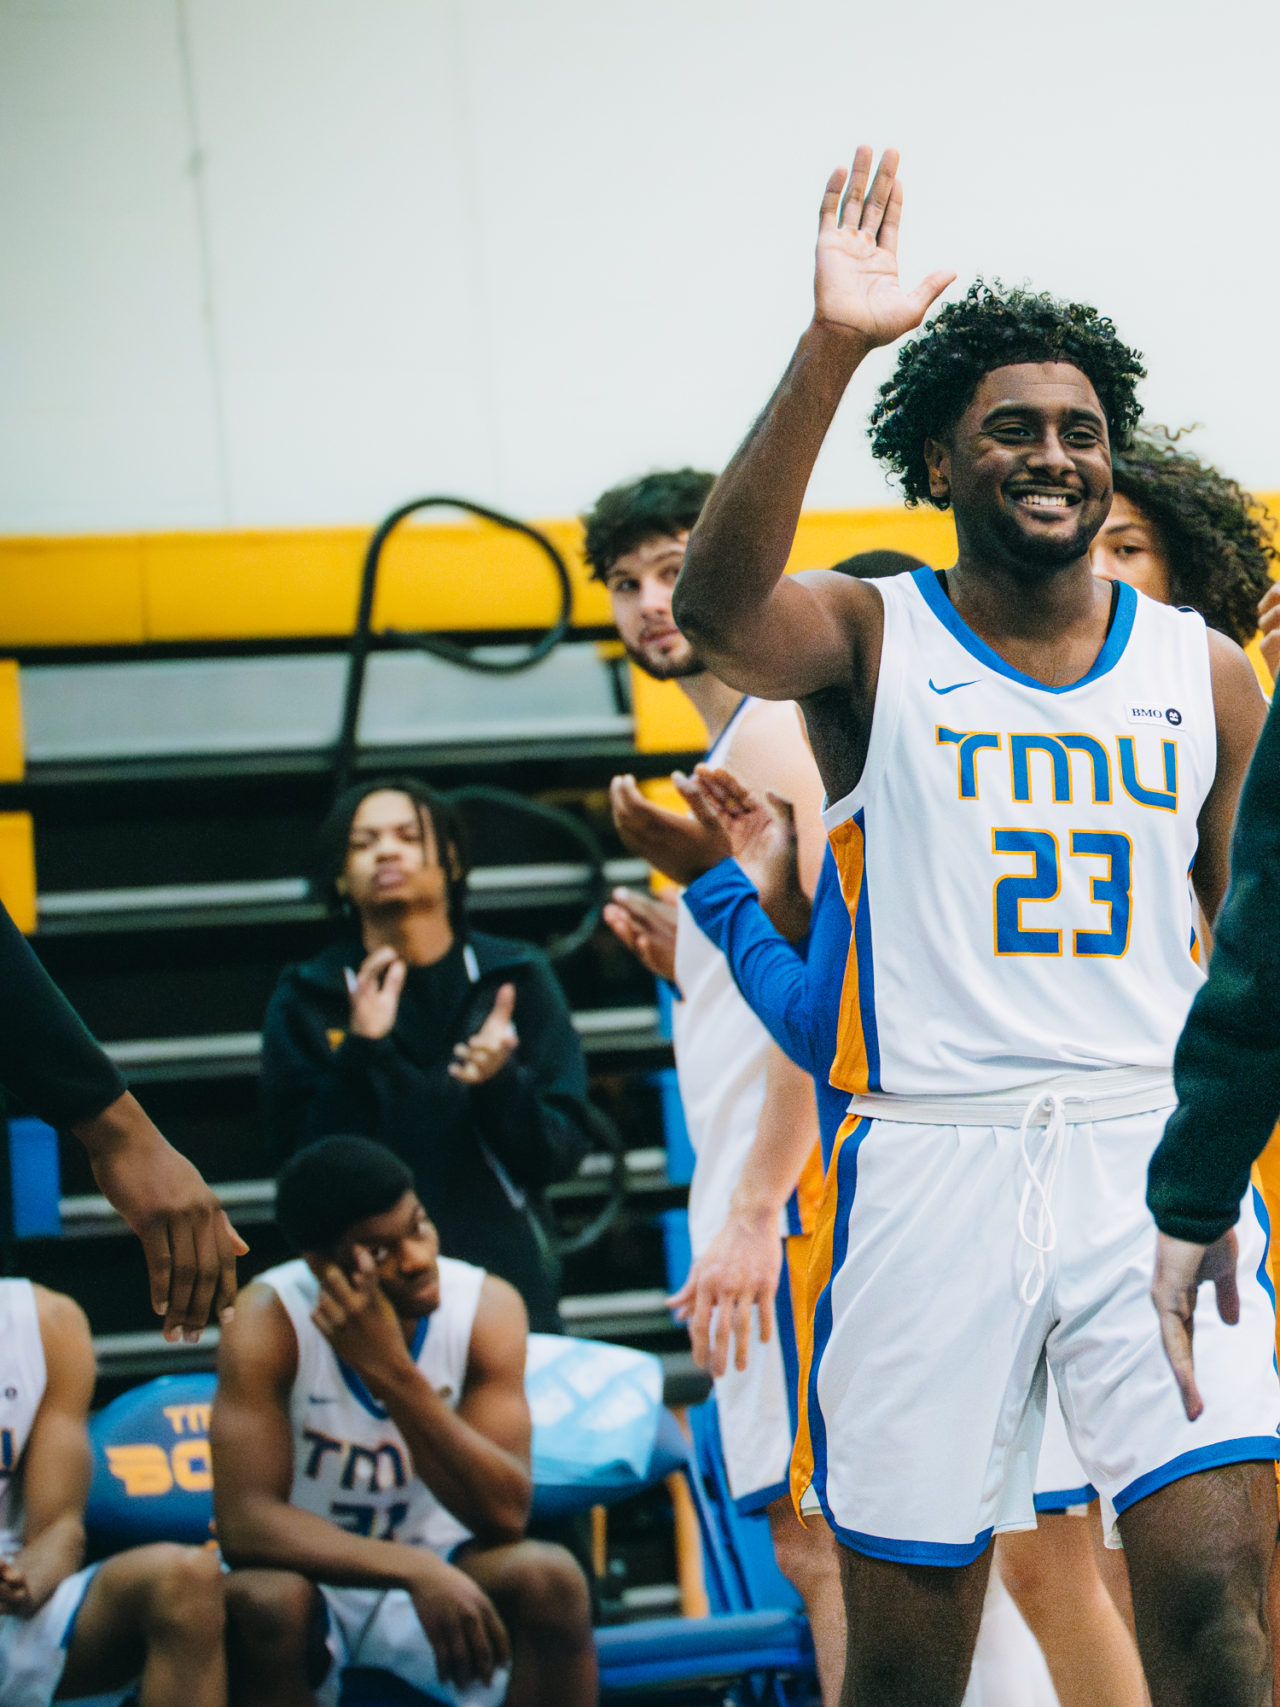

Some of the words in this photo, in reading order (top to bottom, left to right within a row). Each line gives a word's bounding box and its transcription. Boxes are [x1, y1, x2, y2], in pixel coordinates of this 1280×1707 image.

[1131, 708, 1163, 719] BMO
[935, 724, 1178, 815] TMU
[991, 826, 1134, 960] 23
[162, 1403, 213, 1434] TM
[104, 1439, 214, 1497] BO
[302, 1426, 409, 1493] TM
